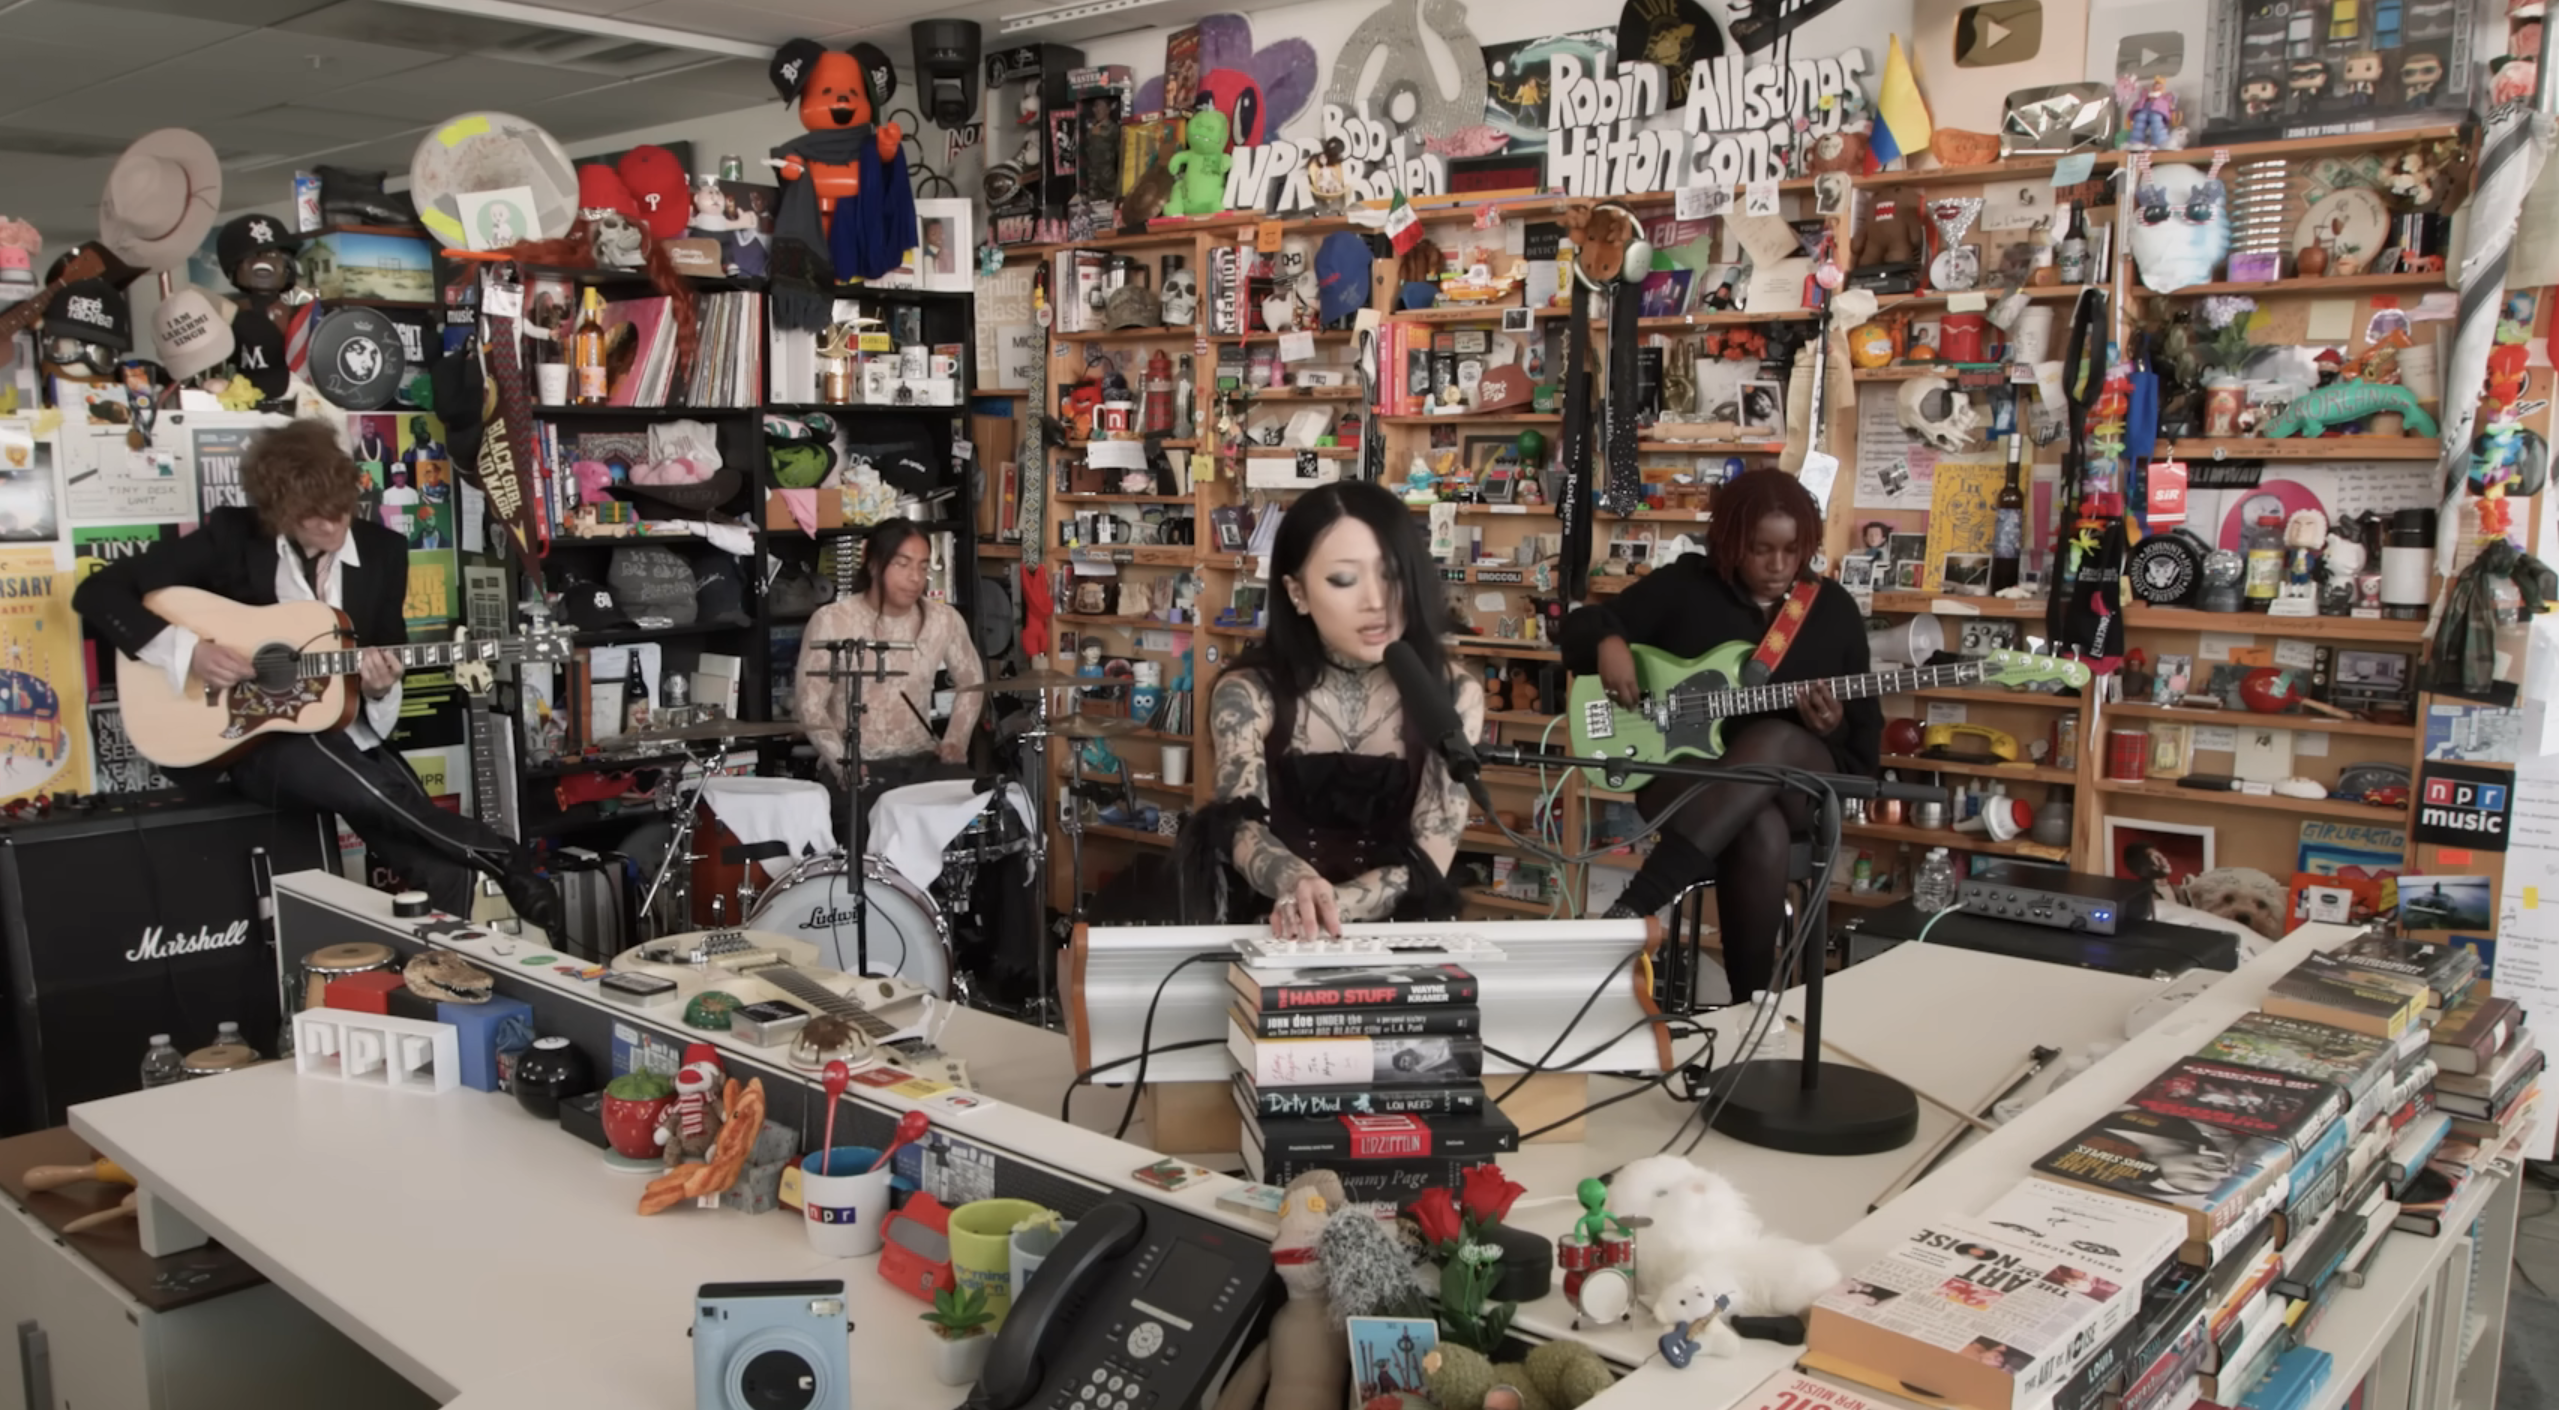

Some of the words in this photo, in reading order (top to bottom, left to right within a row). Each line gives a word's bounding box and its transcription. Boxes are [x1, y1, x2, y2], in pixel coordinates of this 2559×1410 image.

[1549, 50, 1657, 131] Robin
[1685, 47, 1866, 140] Allsongs
[1322, 100, 1388, 162] Bob
[1343, 134, 1445, 204] Boilen
[1548, 121, 1684, 198] Hilton
[1222, 137, 1321, 210] NPR
[997, 214, 1035, 244] KISS
[172, 312, 192, 328] AM
[446, 307, 475, 324] music
[976, 300, 1030, 321] Glass
[485, 418, 512, 476] BLACK
[502, 473, 523, 513] GIRL
[489, 469, 515, 521] MAGIC
[1563, 472, 1579, 536] Rodgers
[0, 576, 53, 598] SARY
[1476, 571, 1522, 583] BROCCOLI
[101, 761, 145, 779] YEAH
[2430, 782, 2497, 807] npr
[2421, 806, 2503, 834] music
[799, 906, 861, 931] Ludwi
[124, 918, 251, 964] Marshall
[1289, 988, 1341, 1006] HARD
[1342, 986, 1398, 1005] STUFF
[1407, 992, 1450, 1004] KRAMER
[1410, 984, 1447, 995] WAYNE
[1266, 1016, 1291, 1030] JOHN
[1292, 1013, 1314, 1029] doe
[1315, 1013, 1346, 1027] UNDER
[1332, 1024, 1362, 1037] BLACK
[304, 1022, 433, 1076] npr
[1268, 1092, 1308, 1114] Dirty
[1385, 1101, 1406, 1112] LOU
[1407, 1100, 1434, 1111] REED
[2073, 1145, 2118, 1163] STAPLES
[2117, 1155, 2158, 1173] MAVIS
[1390, 1168, 1428, 1189] Page
[809, 1204, 851, 1224] npr
[1910, 1228, 2022, 1270] NOISE
[1956, 1263, 2035, 1293] ART
[2032, 1280, 2070, 1299] THE
[1790, 1379, 1836, 1403] MUSIC
